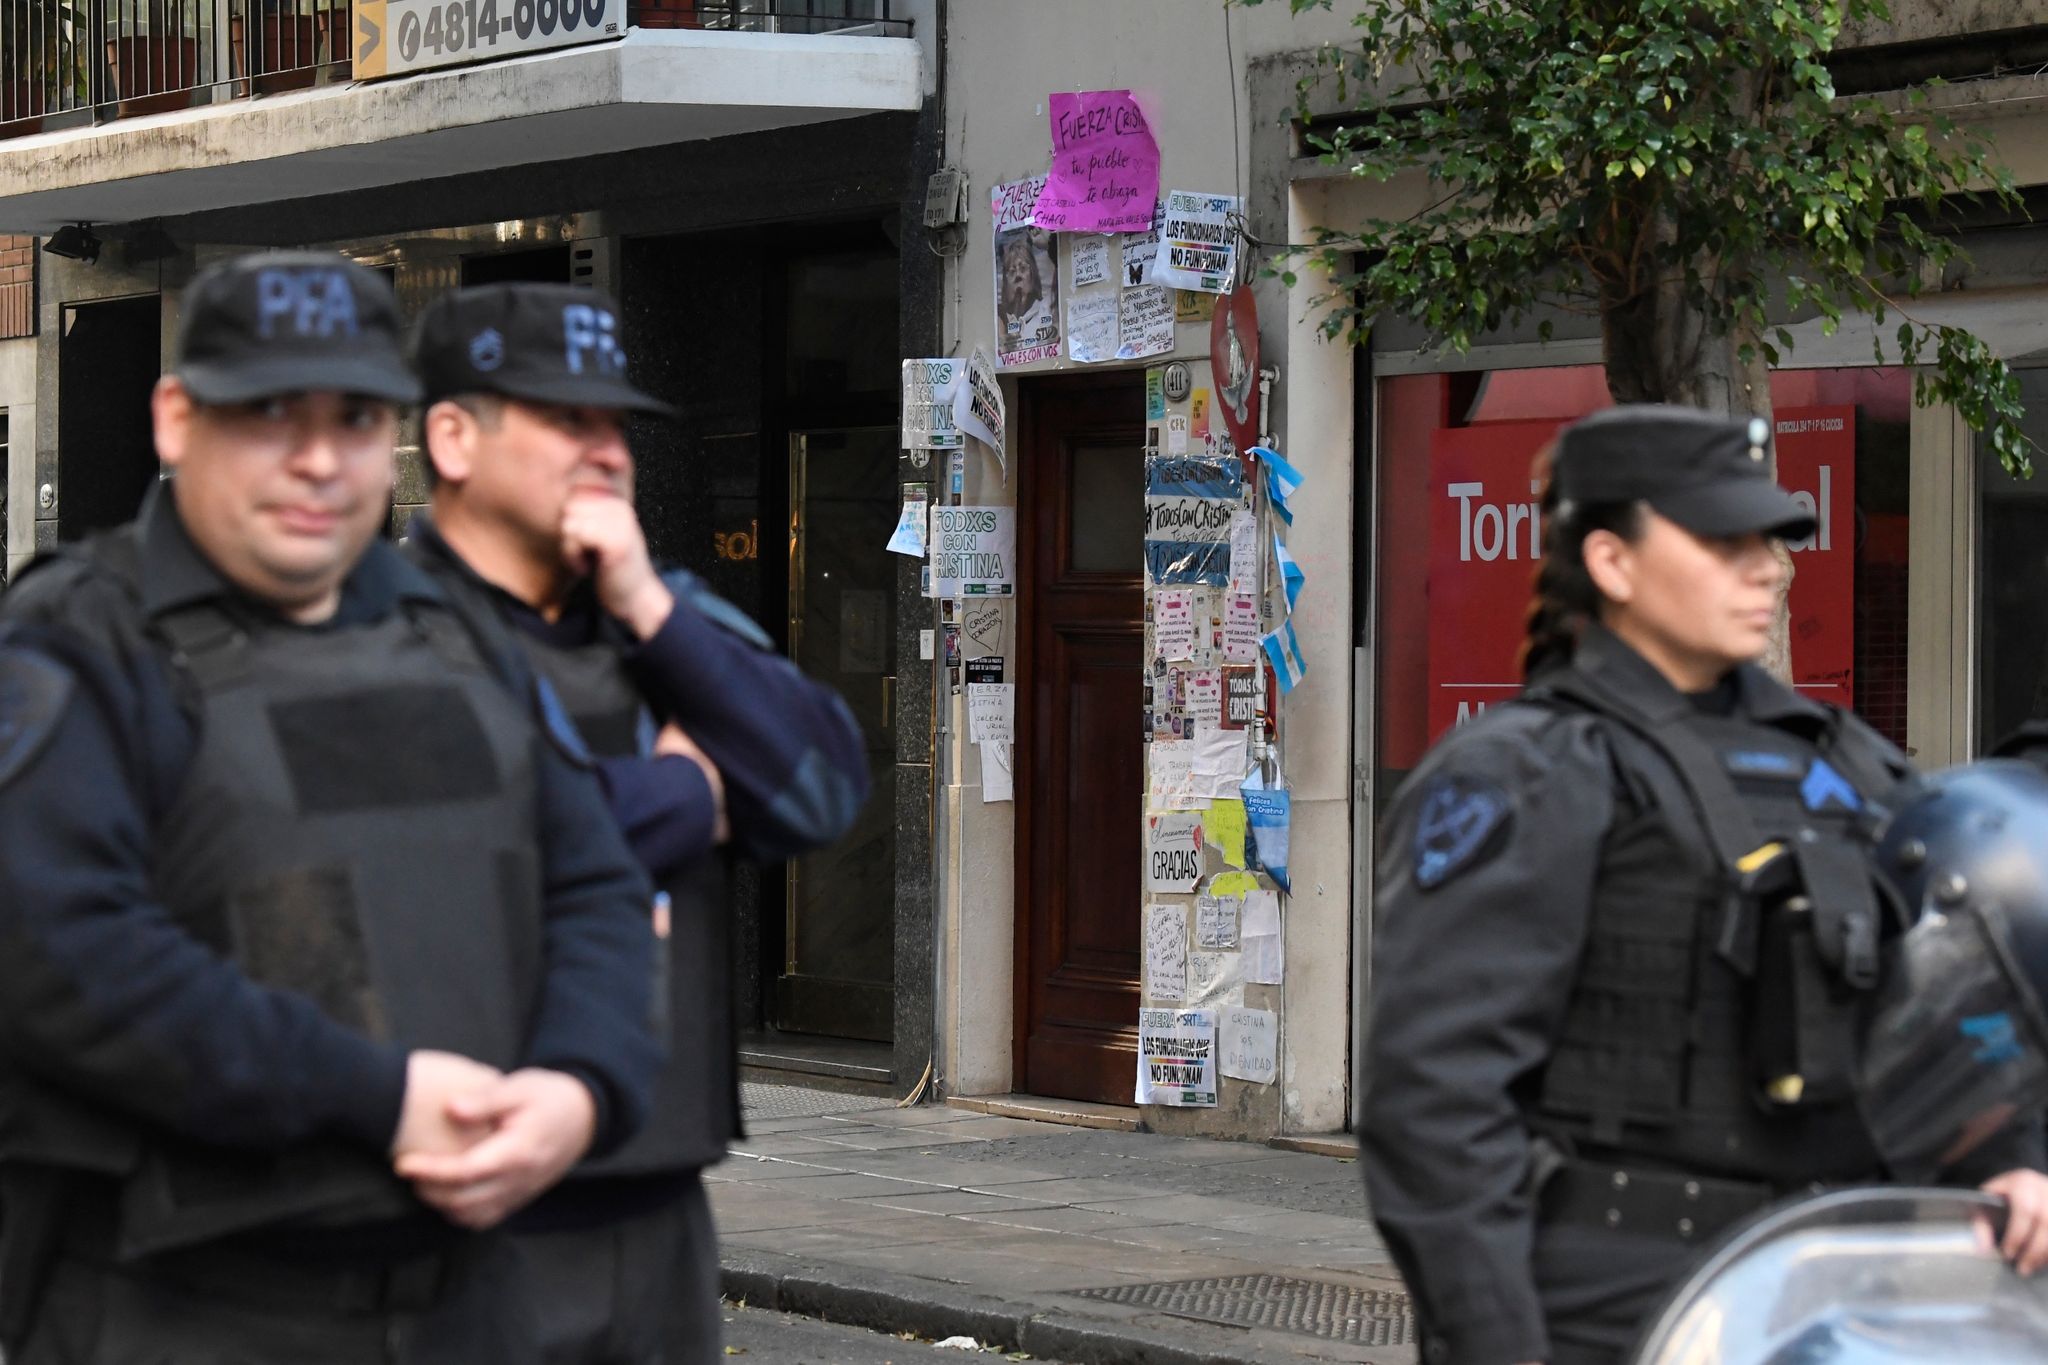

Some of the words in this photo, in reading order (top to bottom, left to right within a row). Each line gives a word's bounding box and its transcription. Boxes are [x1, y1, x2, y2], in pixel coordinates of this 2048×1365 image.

[1059, 106, 1112, 149] FUERZA
[1170, 194, 1203, 212] FUERA
[1001, 203, 1036, 225] CRIST
[1034, 211, 1067, 227] CHACO
[1166, 219, 1180, 239] LOS
[1180, 220, 1223, 243] FUNCIONARIOS
[1222, 225, 1236, 246] QUE
[1170, 248, 1183, 266] NO
[255, 268, 359, 338] PFA
[1001, 350, 1027, 366] VIALES
[1028, 347, 1042, 361] CON
[1043, 344, 1058, 358] VOS
[1166, 371, 1183, 391] 1411
[1447, 481, 1542, 561] Tori
[1787, 465, 1832, 552] al
[943, 534, 977, 551] CON
[934, 553, 1004, 578] RISTINA
[969, 608, 1000, 629] CRISTINA
[1229, 678, 1252, 693] TODAS
[1229, 697, 1256, 720] CRISTI
[1258, 806, 1284, 815] Cristina
[1153, 850, 1197, 880] GRACIAS
[1142, 1011, 1176, 1028] FUERA
[1142, 1037, 1155, 1056] LOS
[1196, 1039, 1210, 1060] QUE
[1151, 1064, 1162, 1082] NO
